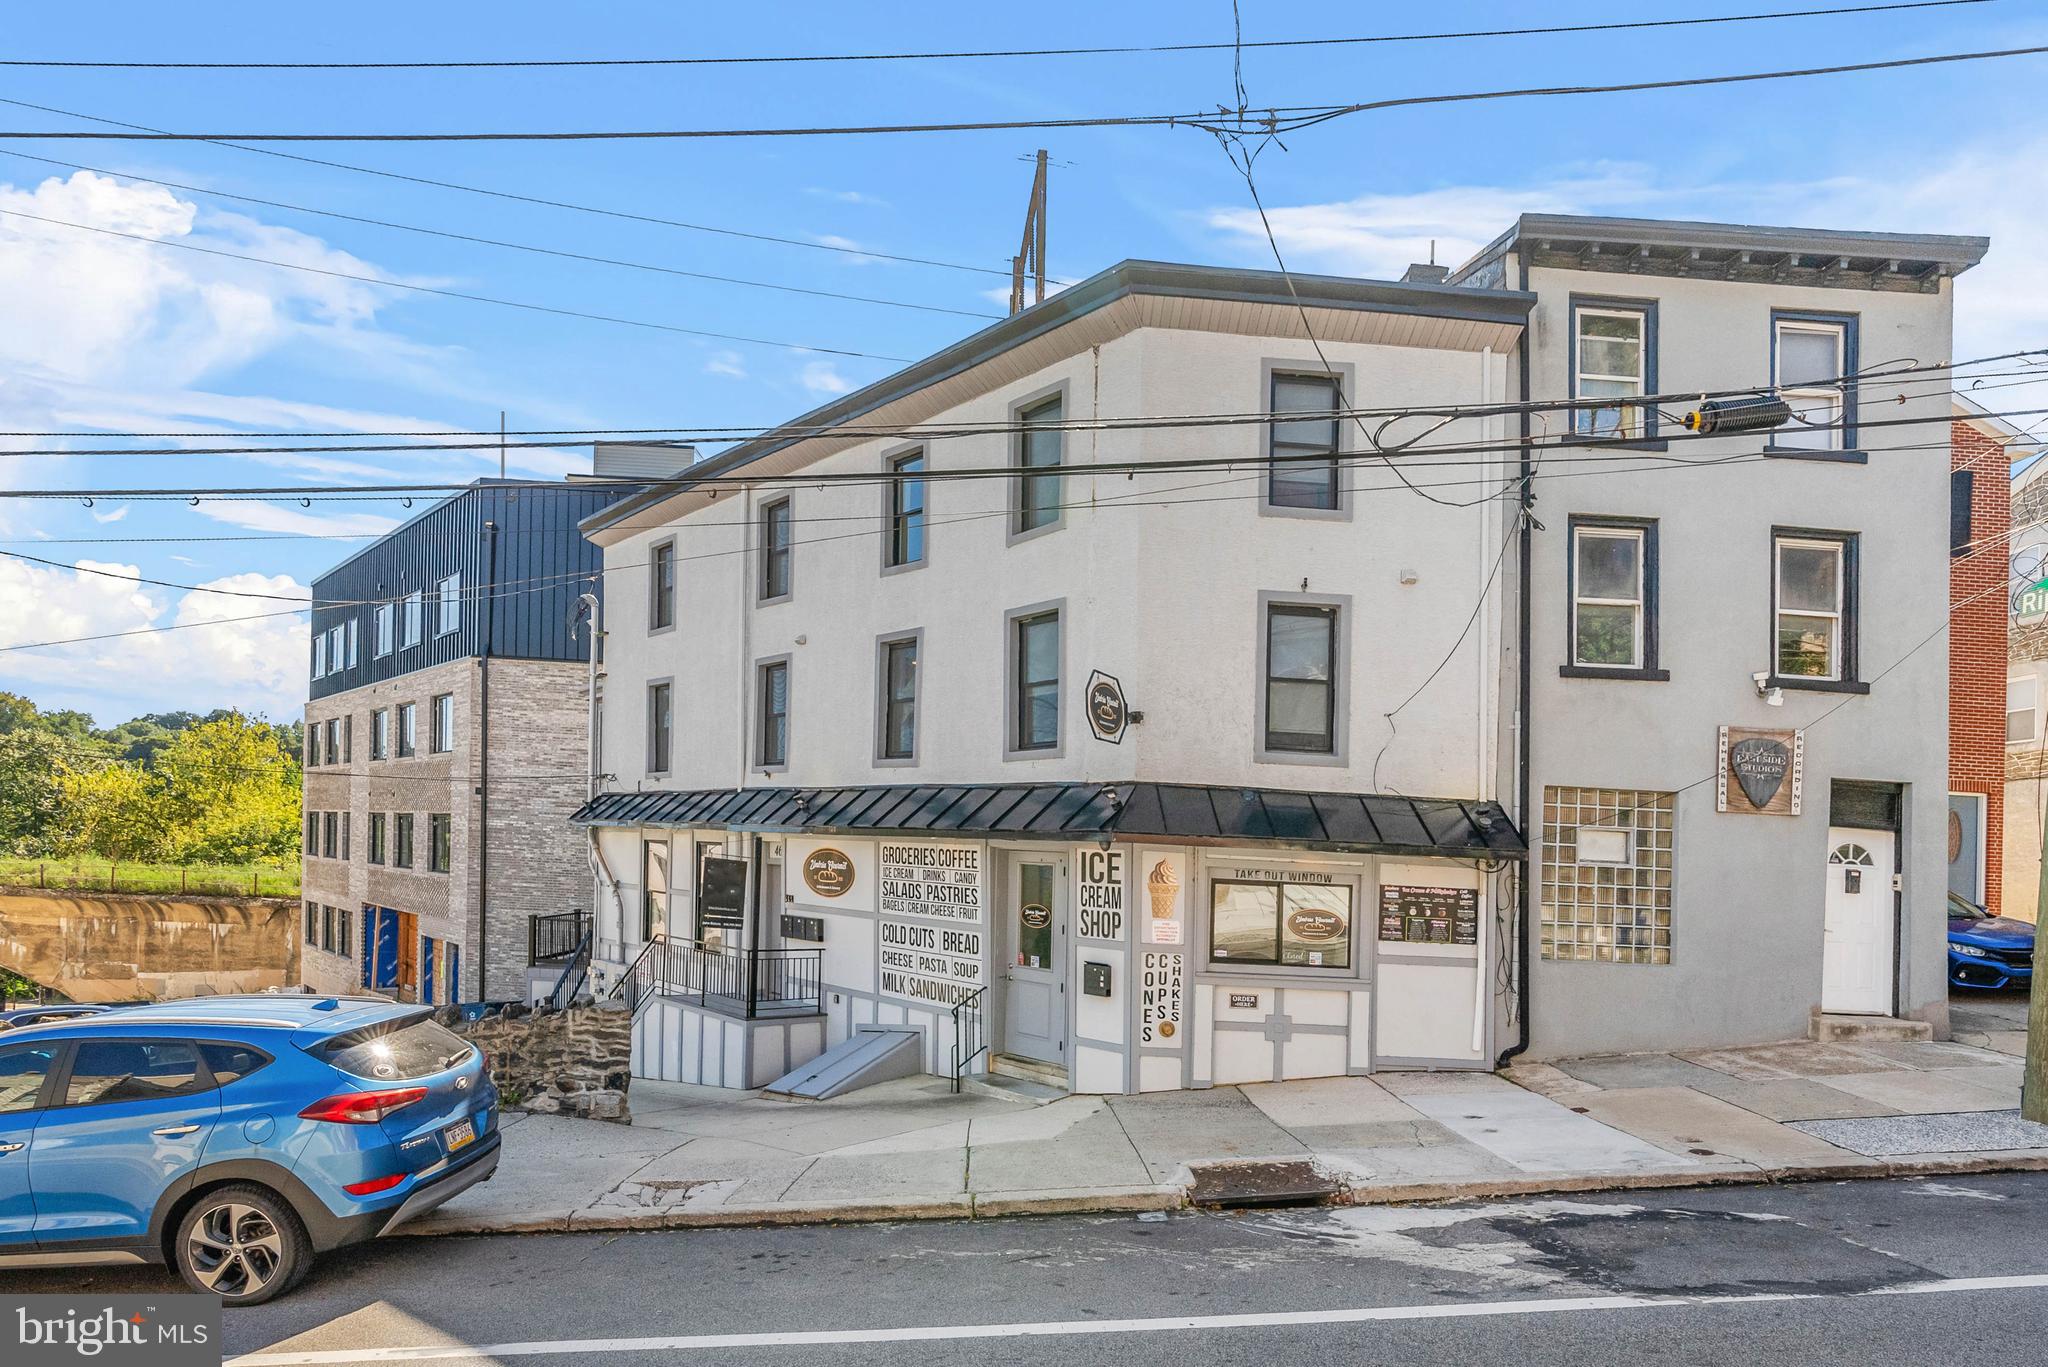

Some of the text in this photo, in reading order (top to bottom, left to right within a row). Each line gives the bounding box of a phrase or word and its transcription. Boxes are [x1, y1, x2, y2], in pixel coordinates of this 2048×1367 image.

[2022, 588, 2048, 614] Ri
[1740, 763, 1783, 773] STUDIOS
[1793, 736, 1802, 808] RECORDING
[882, 846, 978, 869] GROCERIES COFFEE
[1081, 852, 1121, 884] ICE
[883, 867, 977, 884] ICE CREAM DRINKS CANDY
[1234, 869, 1333, 883] TAKE OUT WINDOW
[882, 881, 978, 905] SALADS PASTRIES
[1080, 885, 1121, 909] CREAM
[882, 899, 978, 920] BAGELS CREAM CHEESE FRUIT
[1080, 909, 1121, 939] SHOP
[882, 923, 979, 955] COLD CUTS BREAD
[882, 950, 979, 979] CHEESE PASTA SOUP
[882, 972, 979, 1009] MILK SANDWICHES
[1142, 953, 1155, 1042] CONES
[1157, 953, 1168, 1019] CUPS
[1171, 954, 1181, 1022] SHAKES
